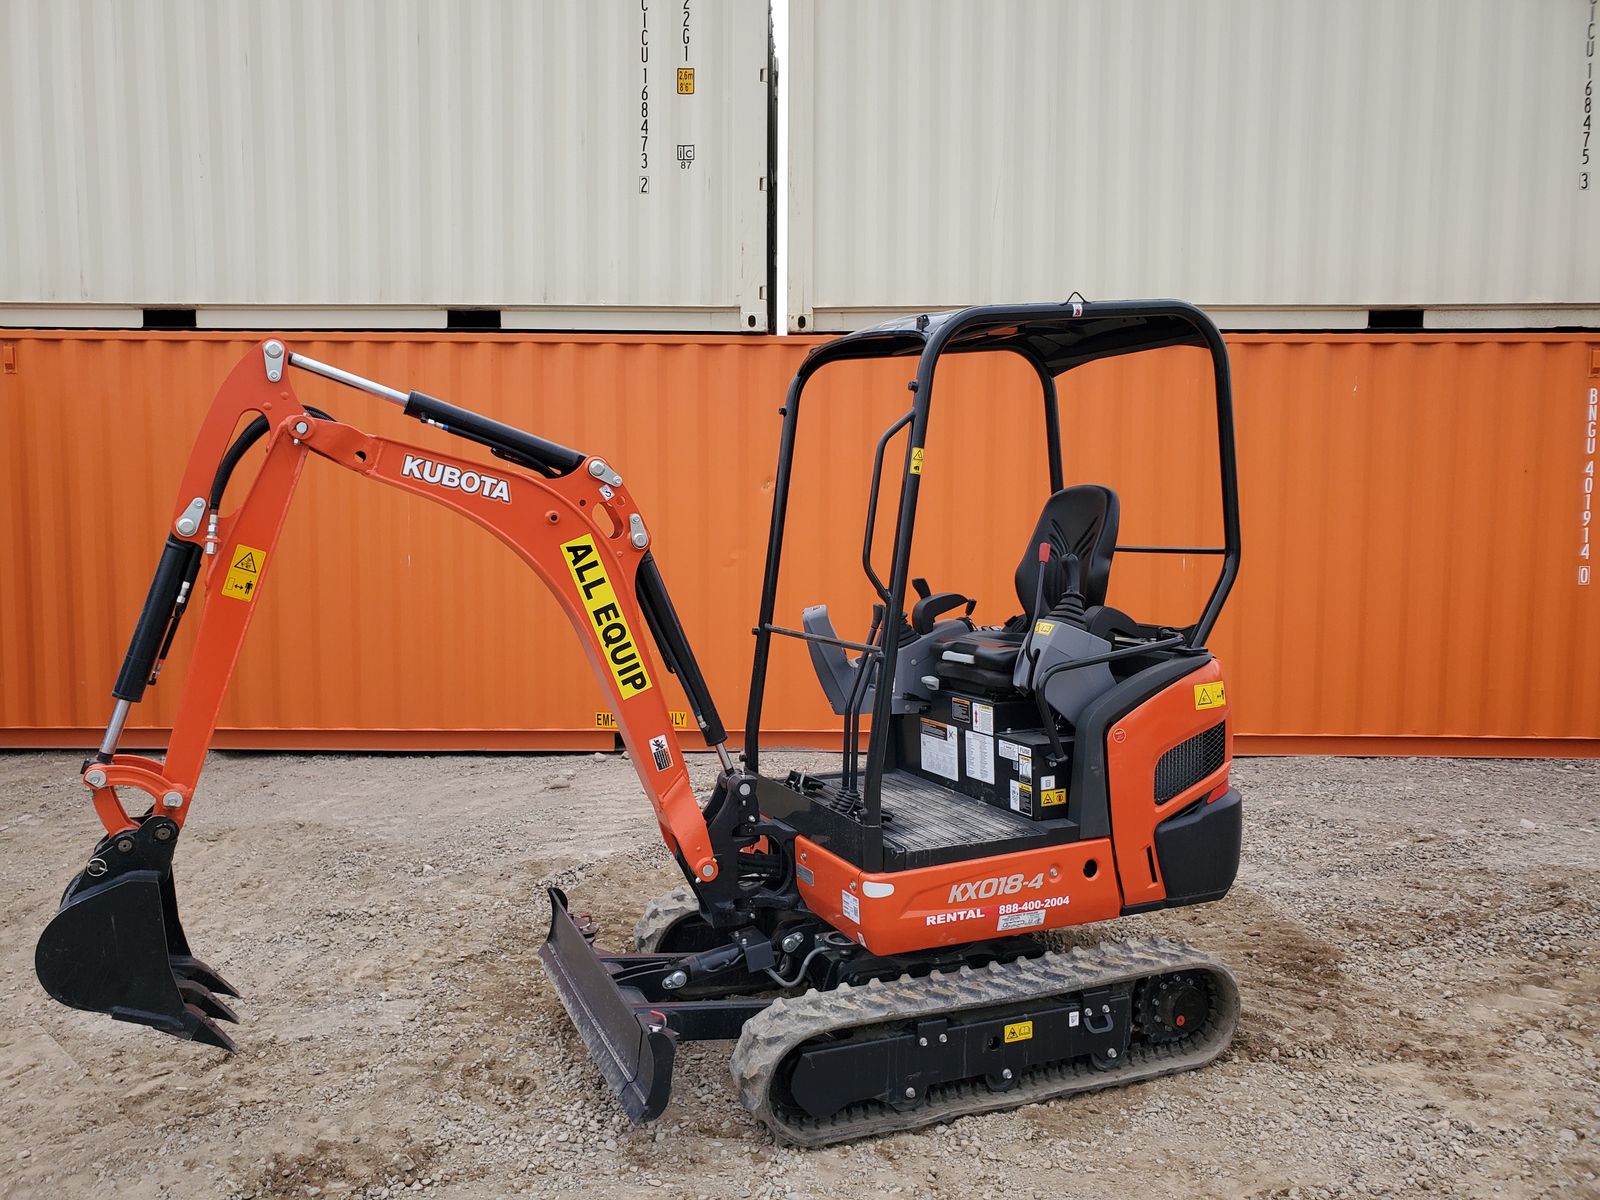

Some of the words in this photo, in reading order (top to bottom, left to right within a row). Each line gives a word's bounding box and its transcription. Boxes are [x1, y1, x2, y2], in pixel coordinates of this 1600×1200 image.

[1582, 63, 1592, 165] 168475
[680, 161, 692, 169] 87
[1580, 172, 1589, 190] 3
[640, 177, 648, 194] 2
[1587, 388, 1598, 454] BNGU
[401, 454, 511, 503] KUBOTA
[1580, 461, 1594, 559] 401914
[565, 543, 607, 601] ALL
[592, 602, 648, 691] EQUIP
[947, 872, 1045, 904] KX018-4
[925, 908, 985, 926] RENTAL
[998, 895, 1071, 915] 888-400-2004
